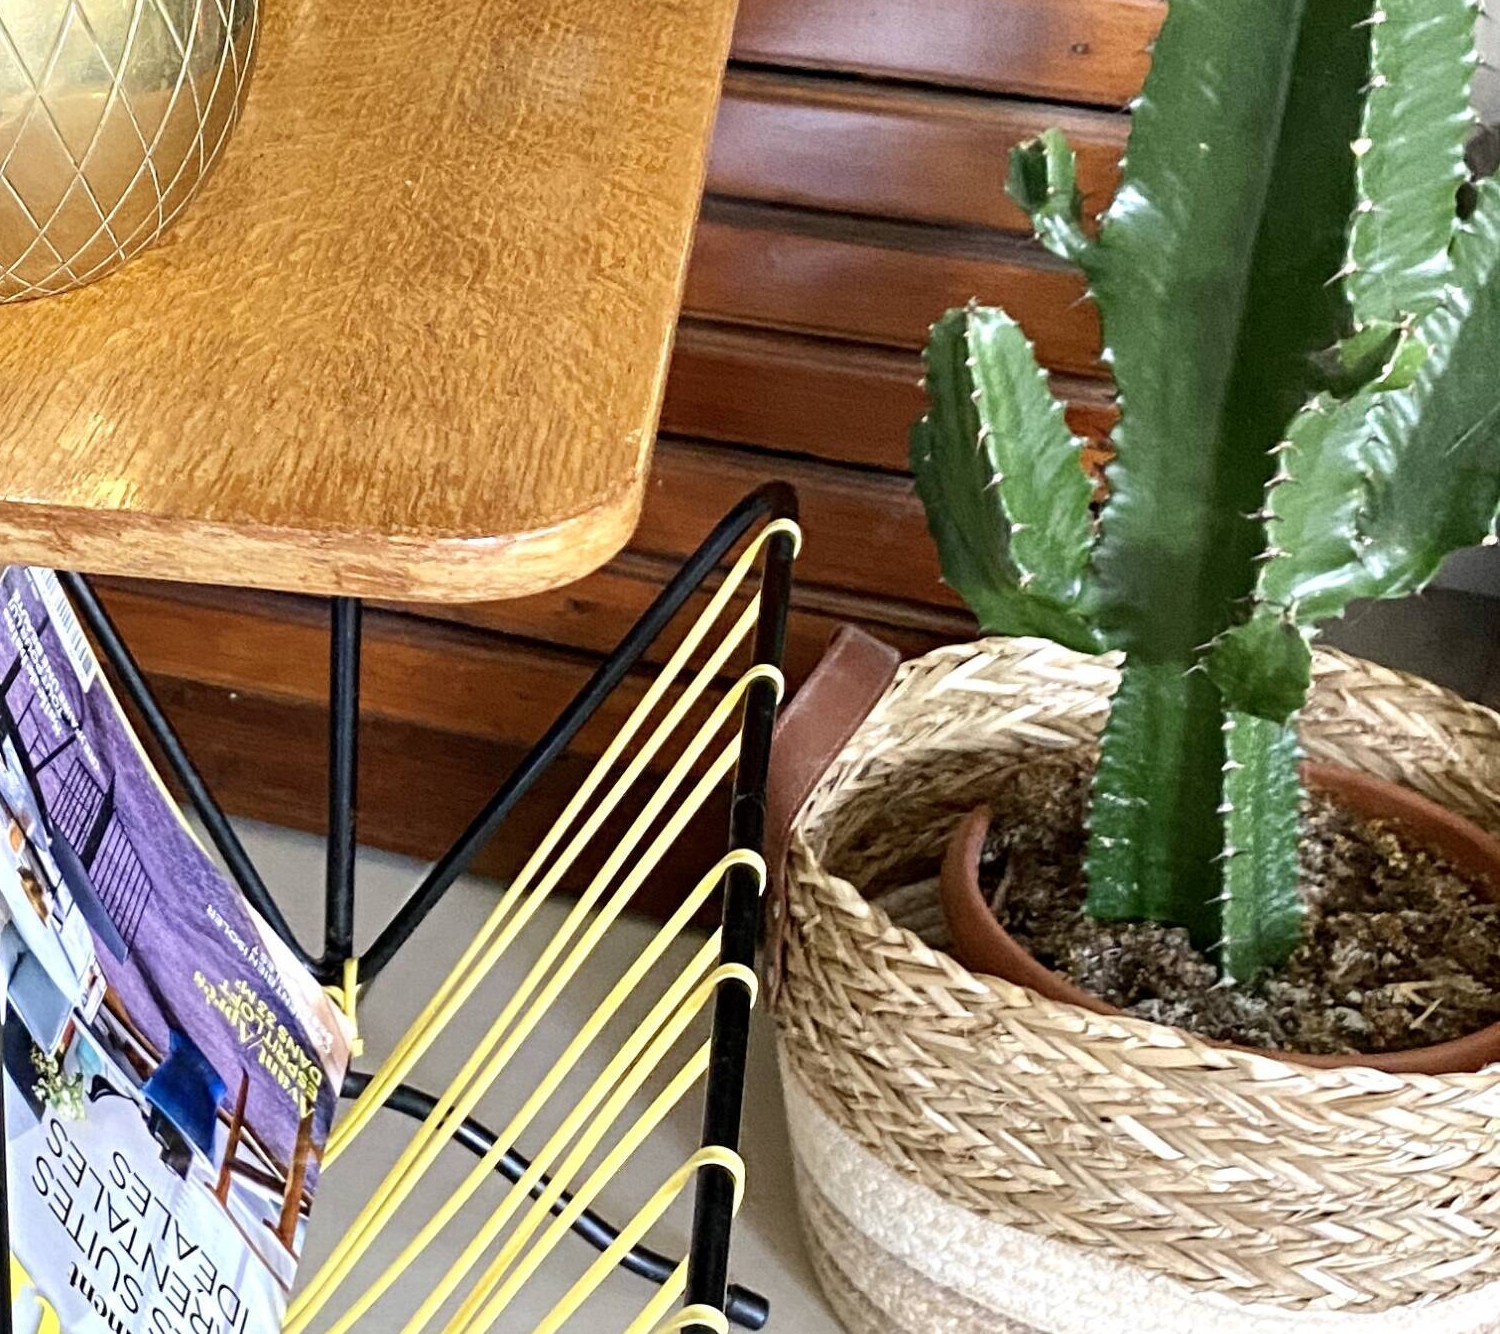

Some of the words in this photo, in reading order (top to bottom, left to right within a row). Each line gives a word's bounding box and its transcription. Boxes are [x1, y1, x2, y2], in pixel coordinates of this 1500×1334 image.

[203, 901, 252, 958] ISOLER
[216, 977, 263, 1035] LOFT
[258, 1028, 321, 1104] ESPRIT
[273, 1023, 324, 1088] DANS
[27, 1155, 145, 1316] SUITES
